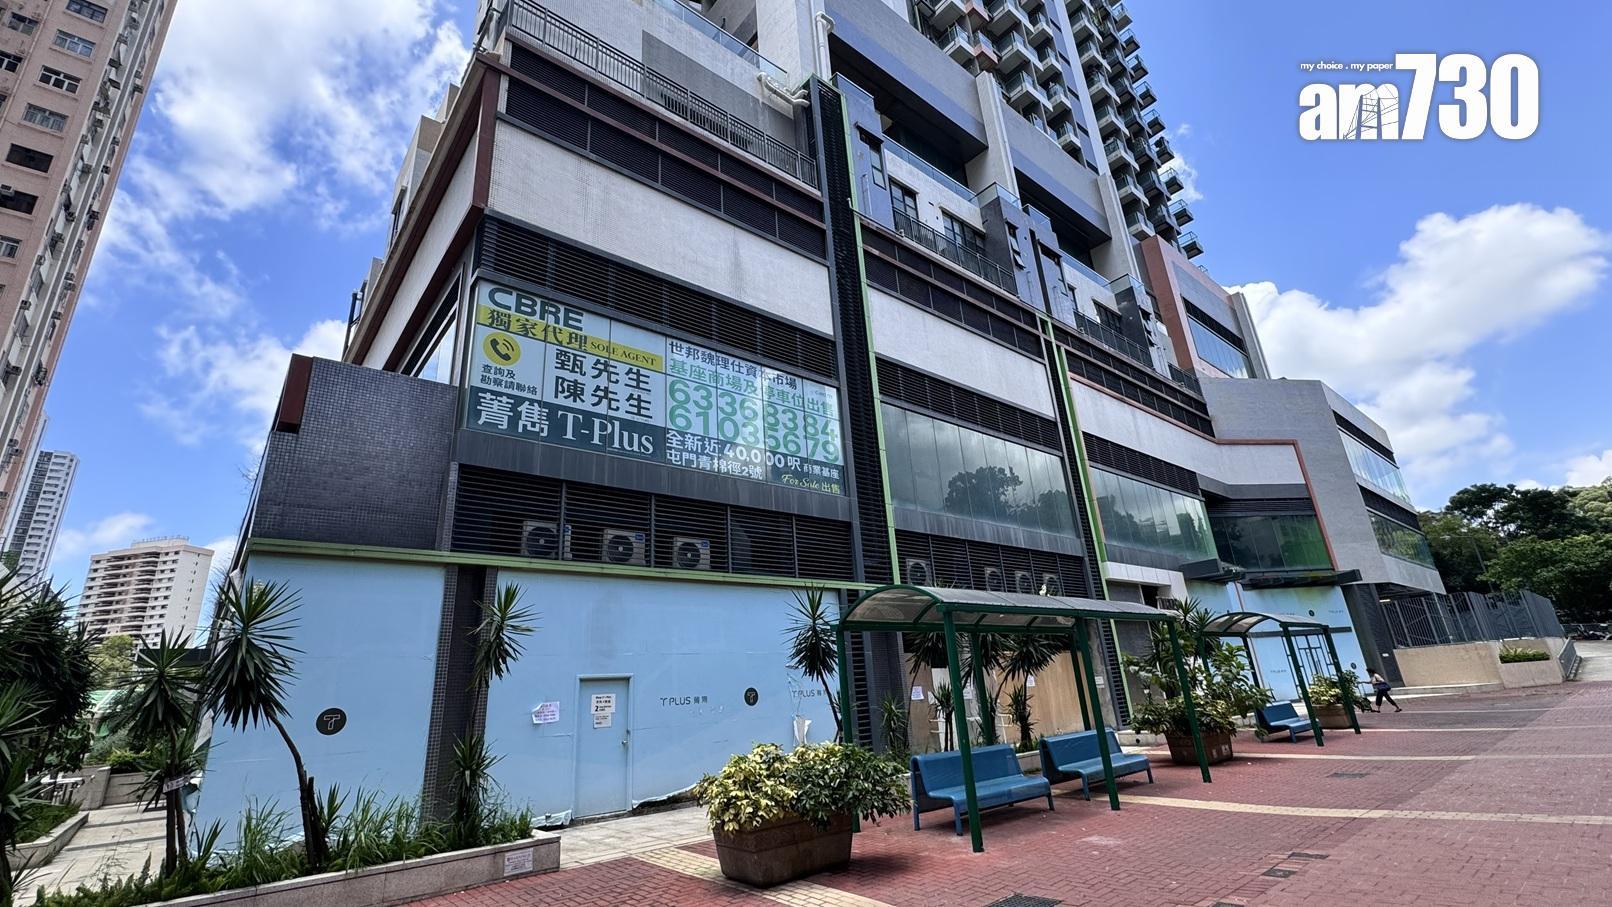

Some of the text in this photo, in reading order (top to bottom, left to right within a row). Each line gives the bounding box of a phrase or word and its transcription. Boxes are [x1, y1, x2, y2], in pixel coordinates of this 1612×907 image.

[488, 287, 584, 331] CBRE
[487, 309, 657, 366] 獨家代理 SOLE AGENT
[481, 364, 516, 380] 查詢及
[554, 348, 652, 393] 甄先生
[554, 375, 653, 420] 陳先生
[557, 410, 654, 454] T-Plus
[781, 474, 799, 485] For
[800, 478, 820, 489] Sale
